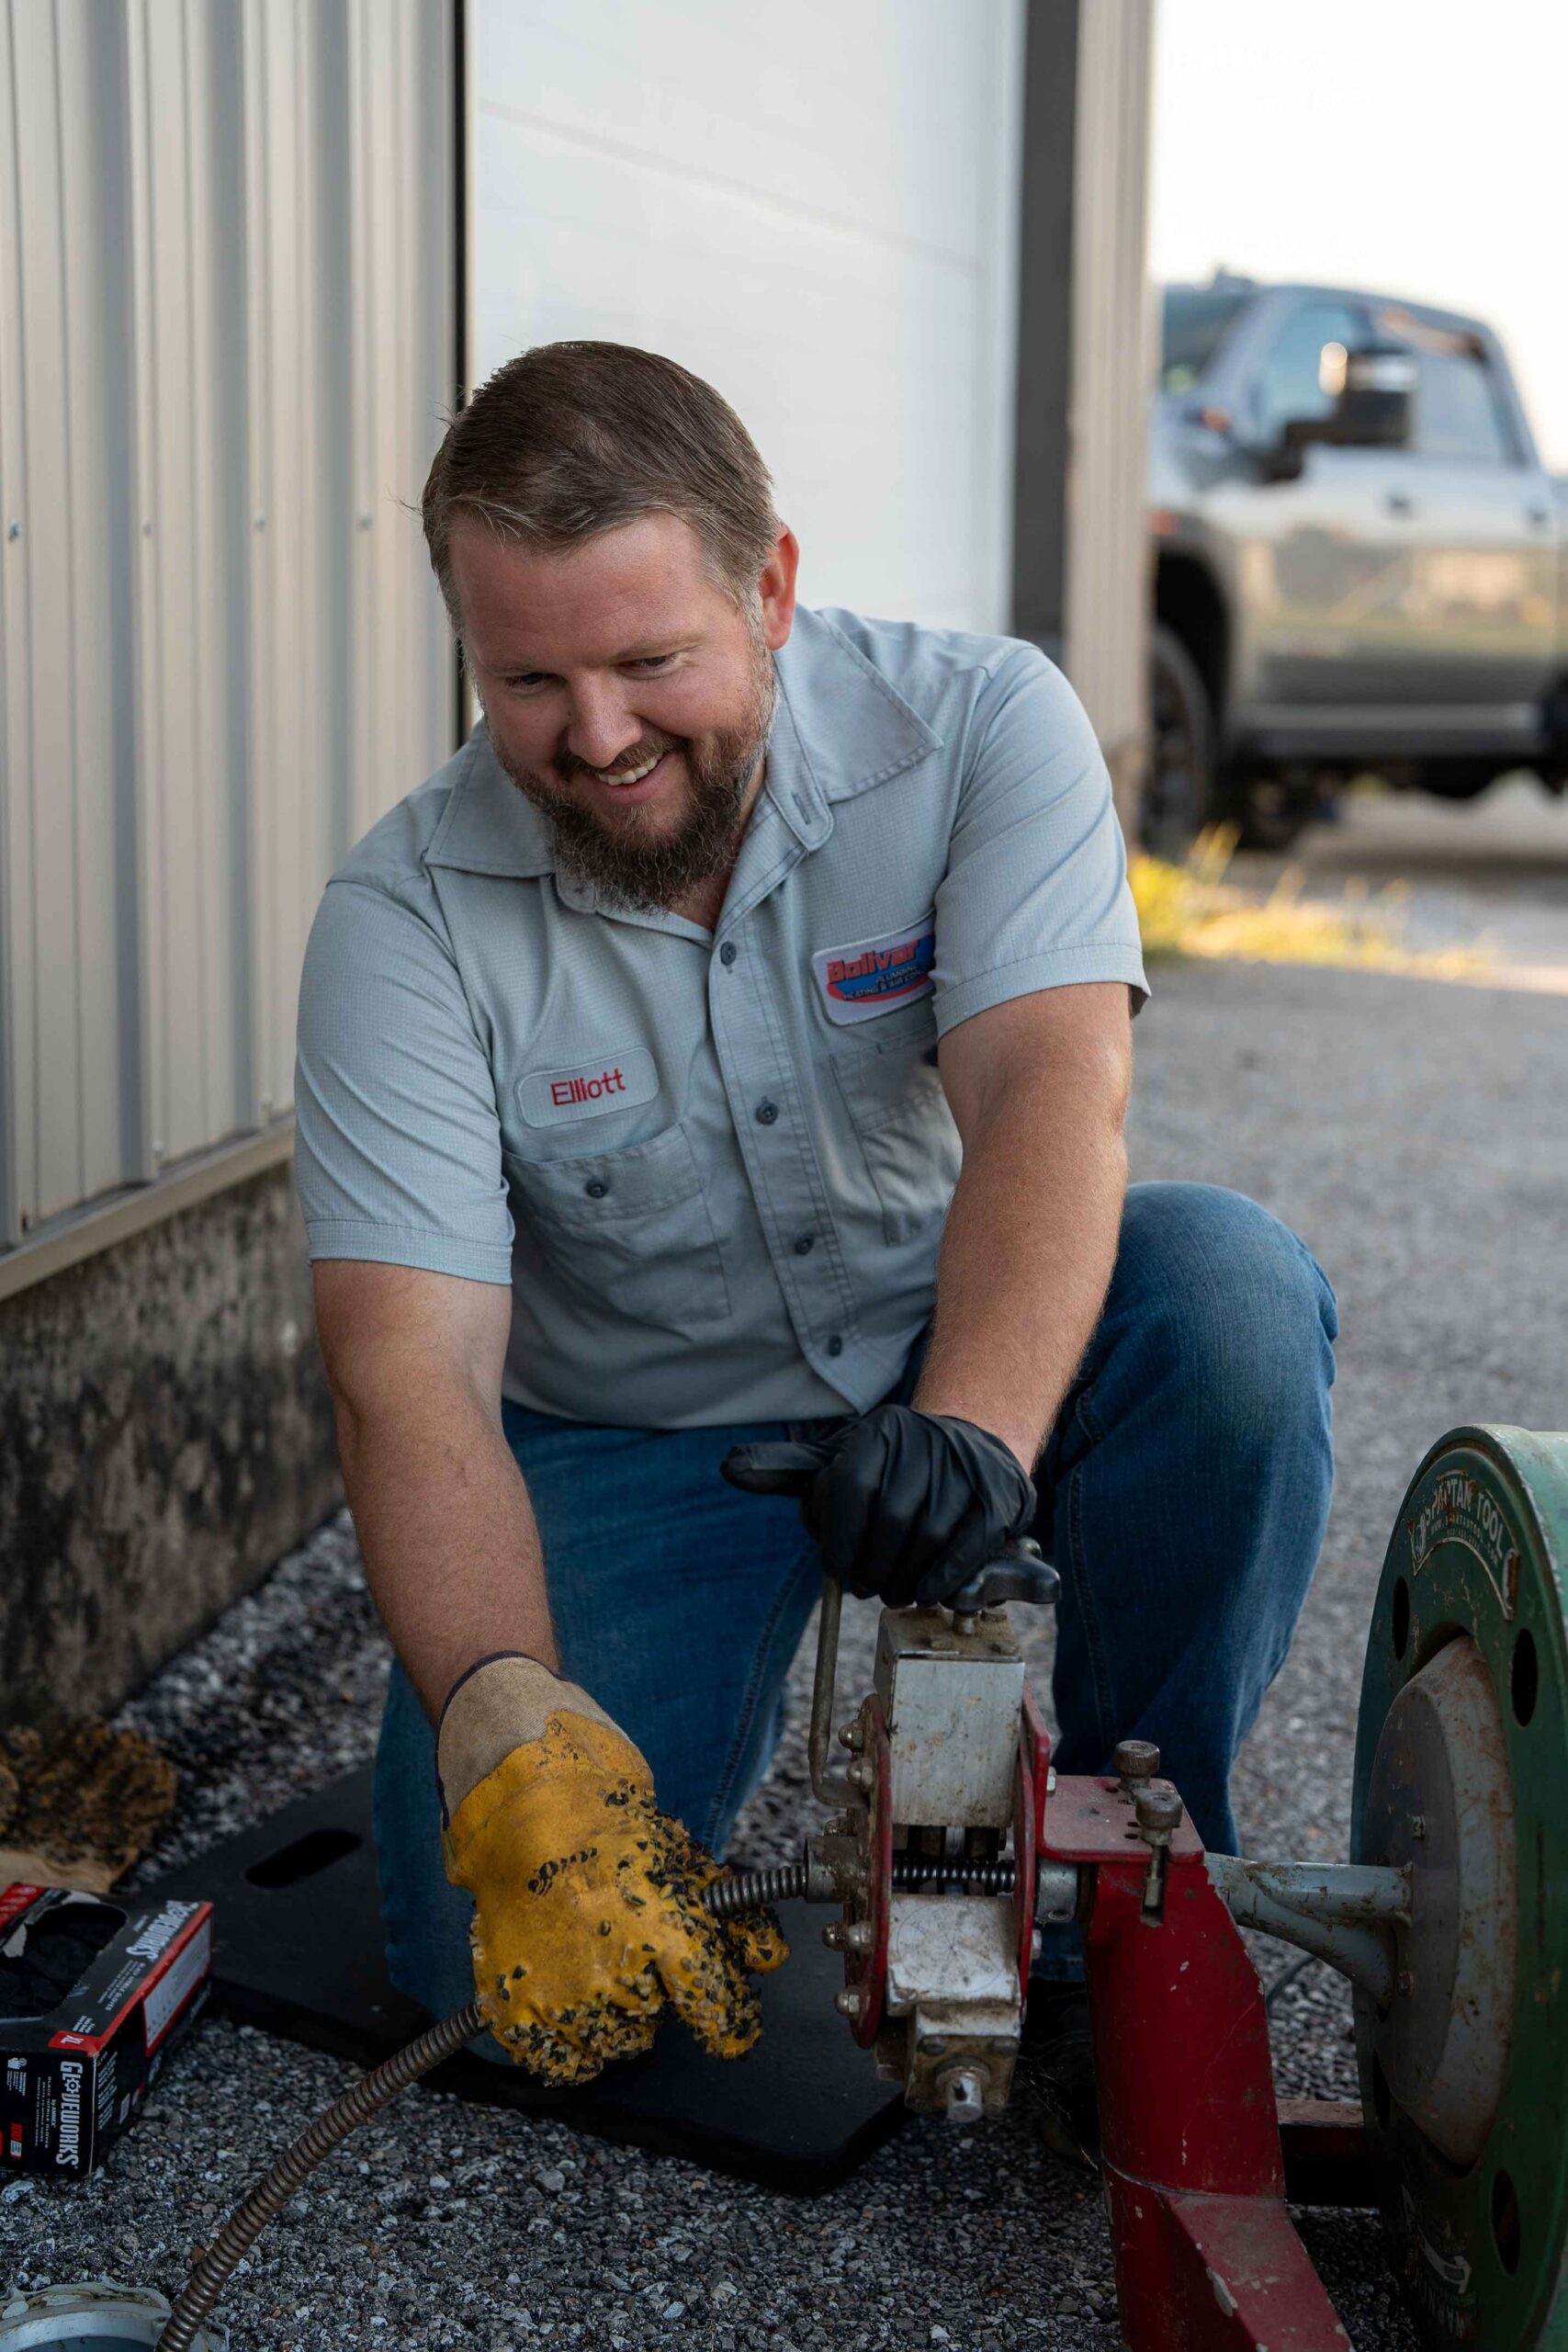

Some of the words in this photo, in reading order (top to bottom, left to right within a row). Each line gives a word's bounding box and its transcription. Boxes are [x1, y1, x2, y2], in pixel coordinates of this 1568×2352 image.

[828, 940, 919, 982] Bolivar
[551, 1069, 626, 1105] Elliott
[1476, 1492, 1504, 1559] TOOL
[55, 2061, 84, 2165] GLOVEWORKS
